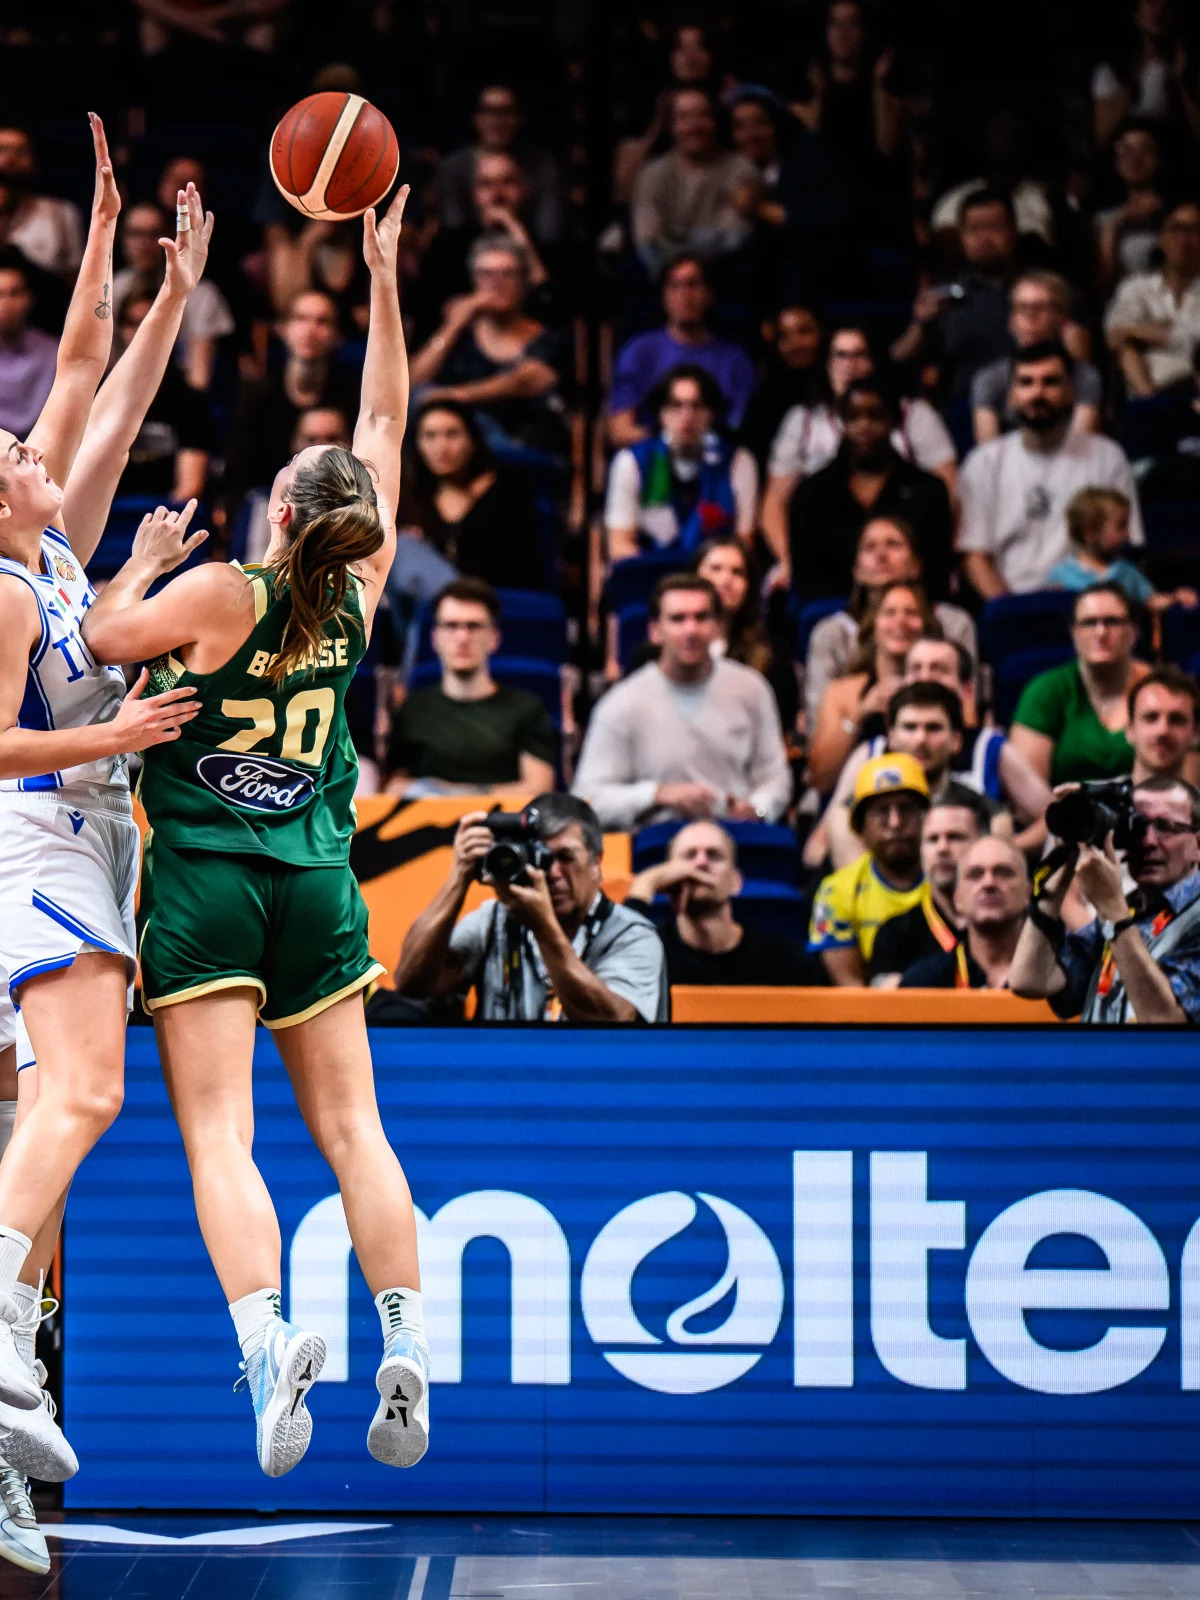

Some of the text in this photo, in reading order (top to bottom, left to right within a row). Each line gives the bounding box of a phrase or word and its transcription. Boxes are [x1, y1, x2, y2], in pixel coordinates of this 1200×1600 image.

[246, 638, 349, 678] BLASE
[216, 687, 335, 766] 20
[220, 762, 304, 807] Ford
[290, 1150, 1200, 1395] molte
